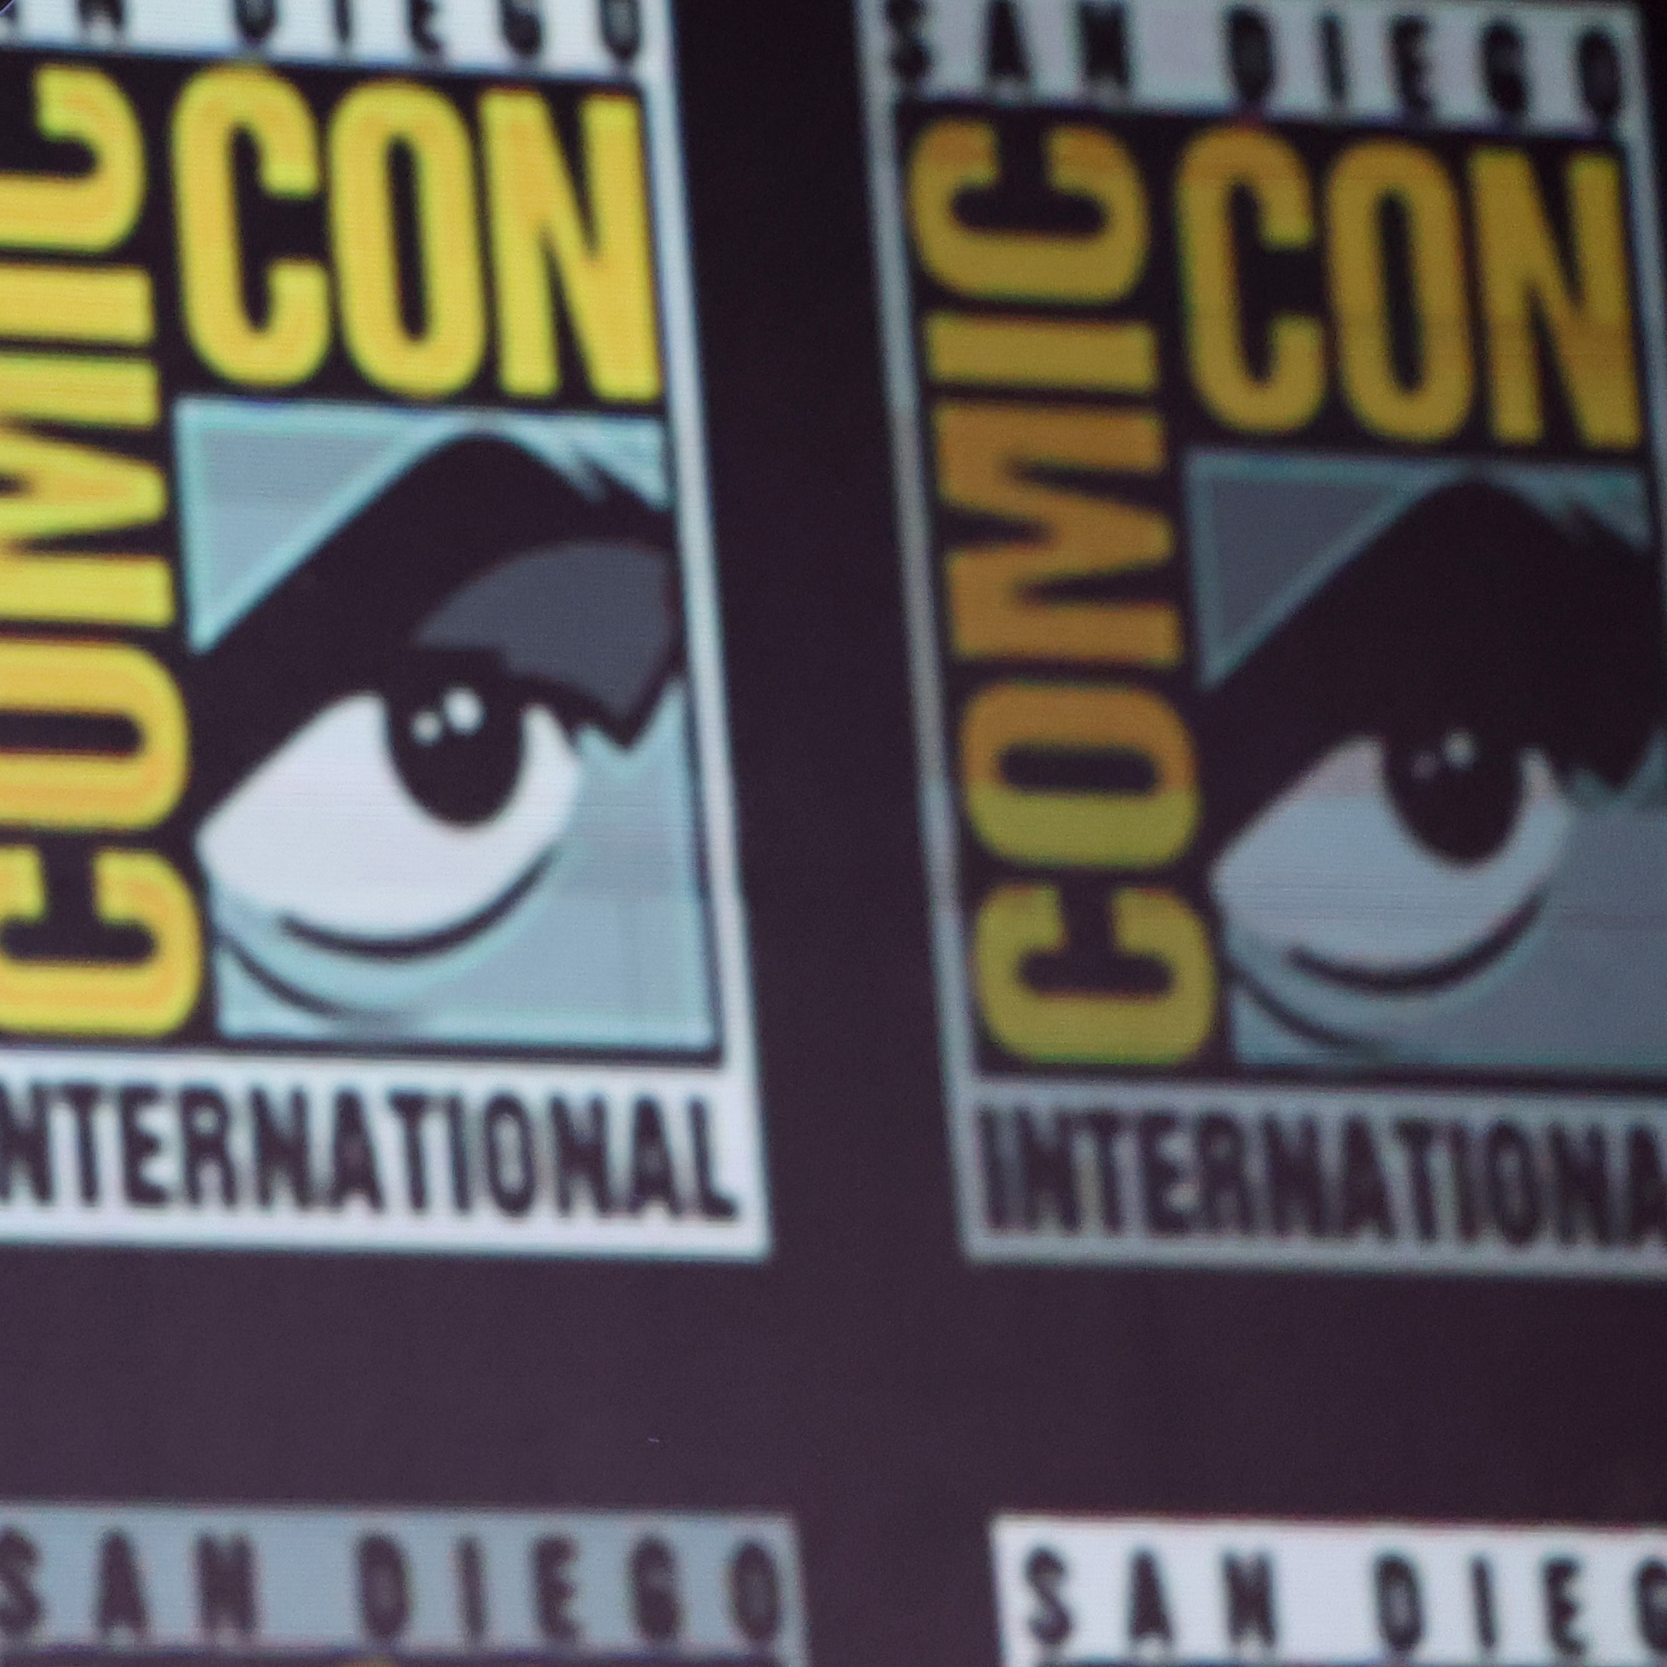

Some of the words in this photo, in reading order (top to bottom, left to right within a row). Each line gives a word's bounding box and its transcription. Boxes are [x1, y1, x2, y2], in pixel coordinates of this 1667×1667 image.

[1223, 2, 1626, 123] DIEGO
[170, 63, 663, 403] CON
[1174, 121, 1643, 450] CON
[907, 119, 1219, 1066] COMIC
[353, 1528, 784, 1645] DIEGO
[1022, 1544, 1280, 1650] SAN
